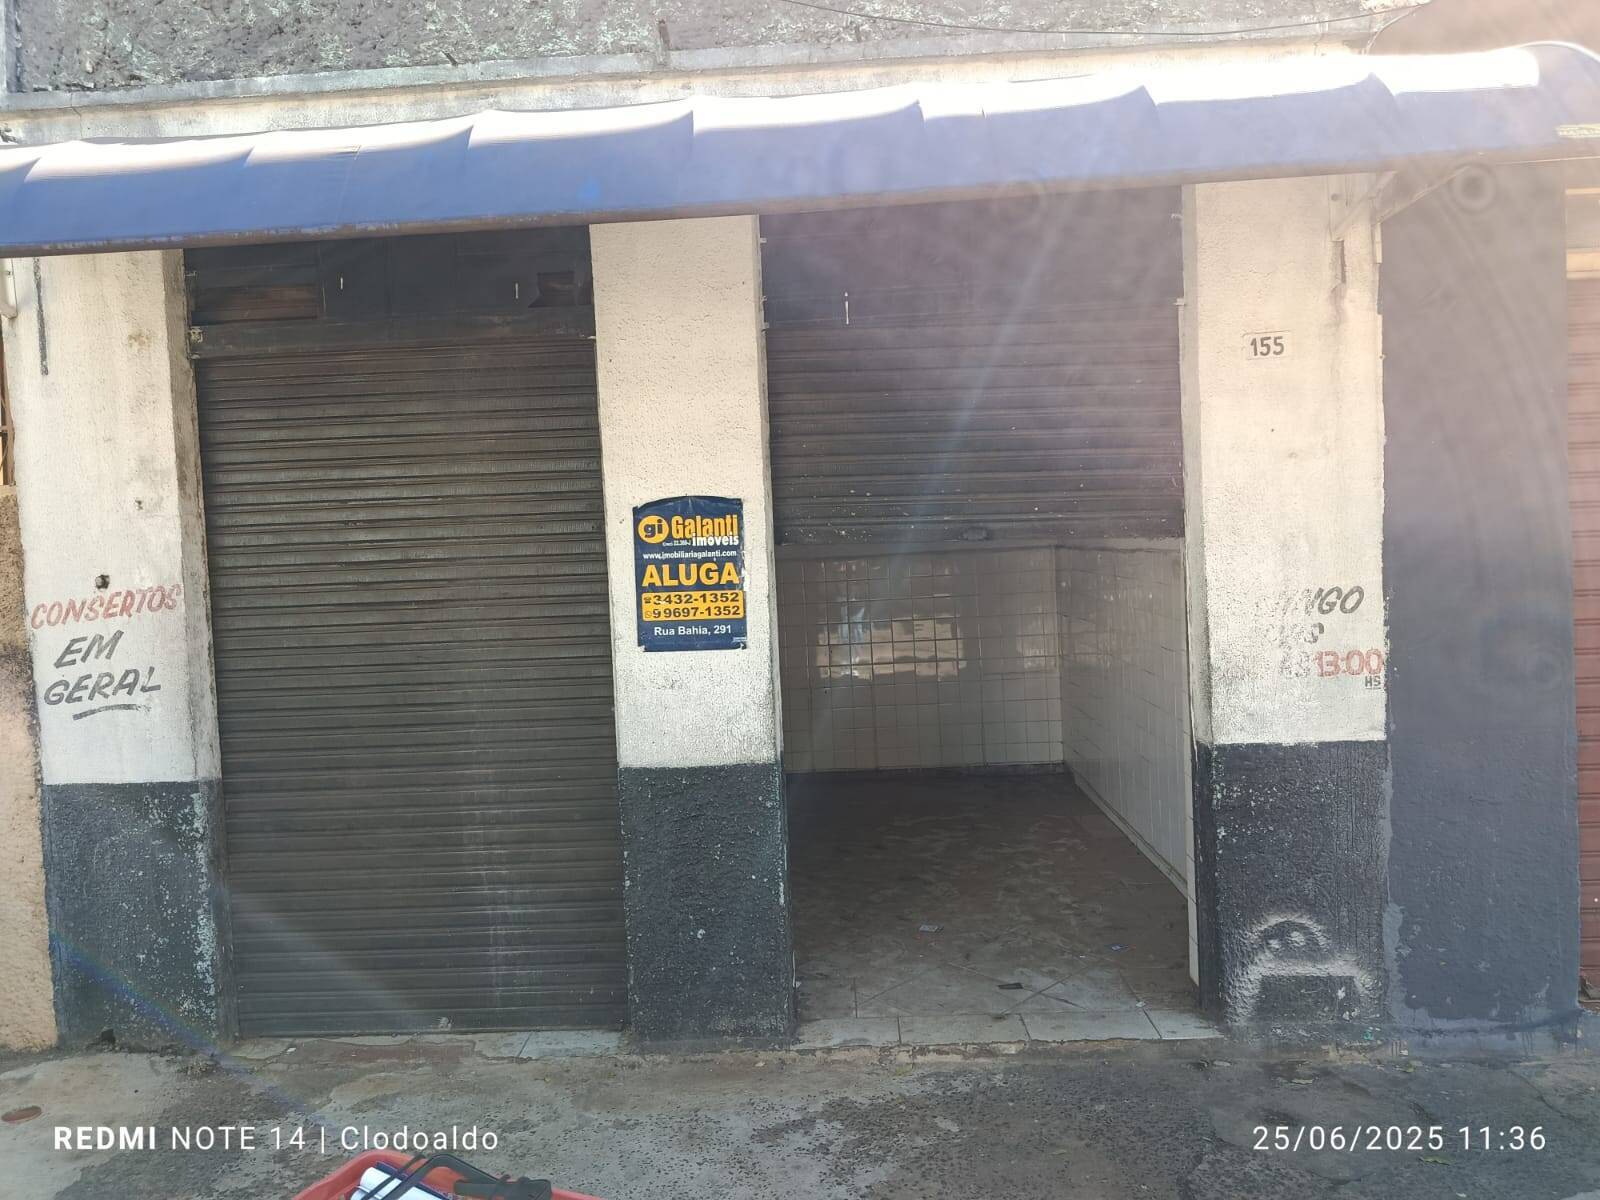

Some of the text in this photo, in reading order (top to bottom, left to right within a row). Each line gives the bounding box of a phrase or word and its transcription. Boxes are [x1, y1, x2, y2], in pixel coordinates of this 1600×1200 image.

[1250, 335, 1285, 357] 155
[671, 514, 739, 540] Galanti
[642, 549, 737, 560] www.imobiliariagalanti.com
[641, 562, 740, 587] ALUGA
[30, 583, 182, 630] CONSERTOS
[653, 592, 740, 605] 3432-1352
[653, 624, 732, 636] Rua Bahia, 291
[53, 629, 125, 669] EM
[43, 665, 162, 706] GERAL
[1364, 675, 1382, 688] HS
